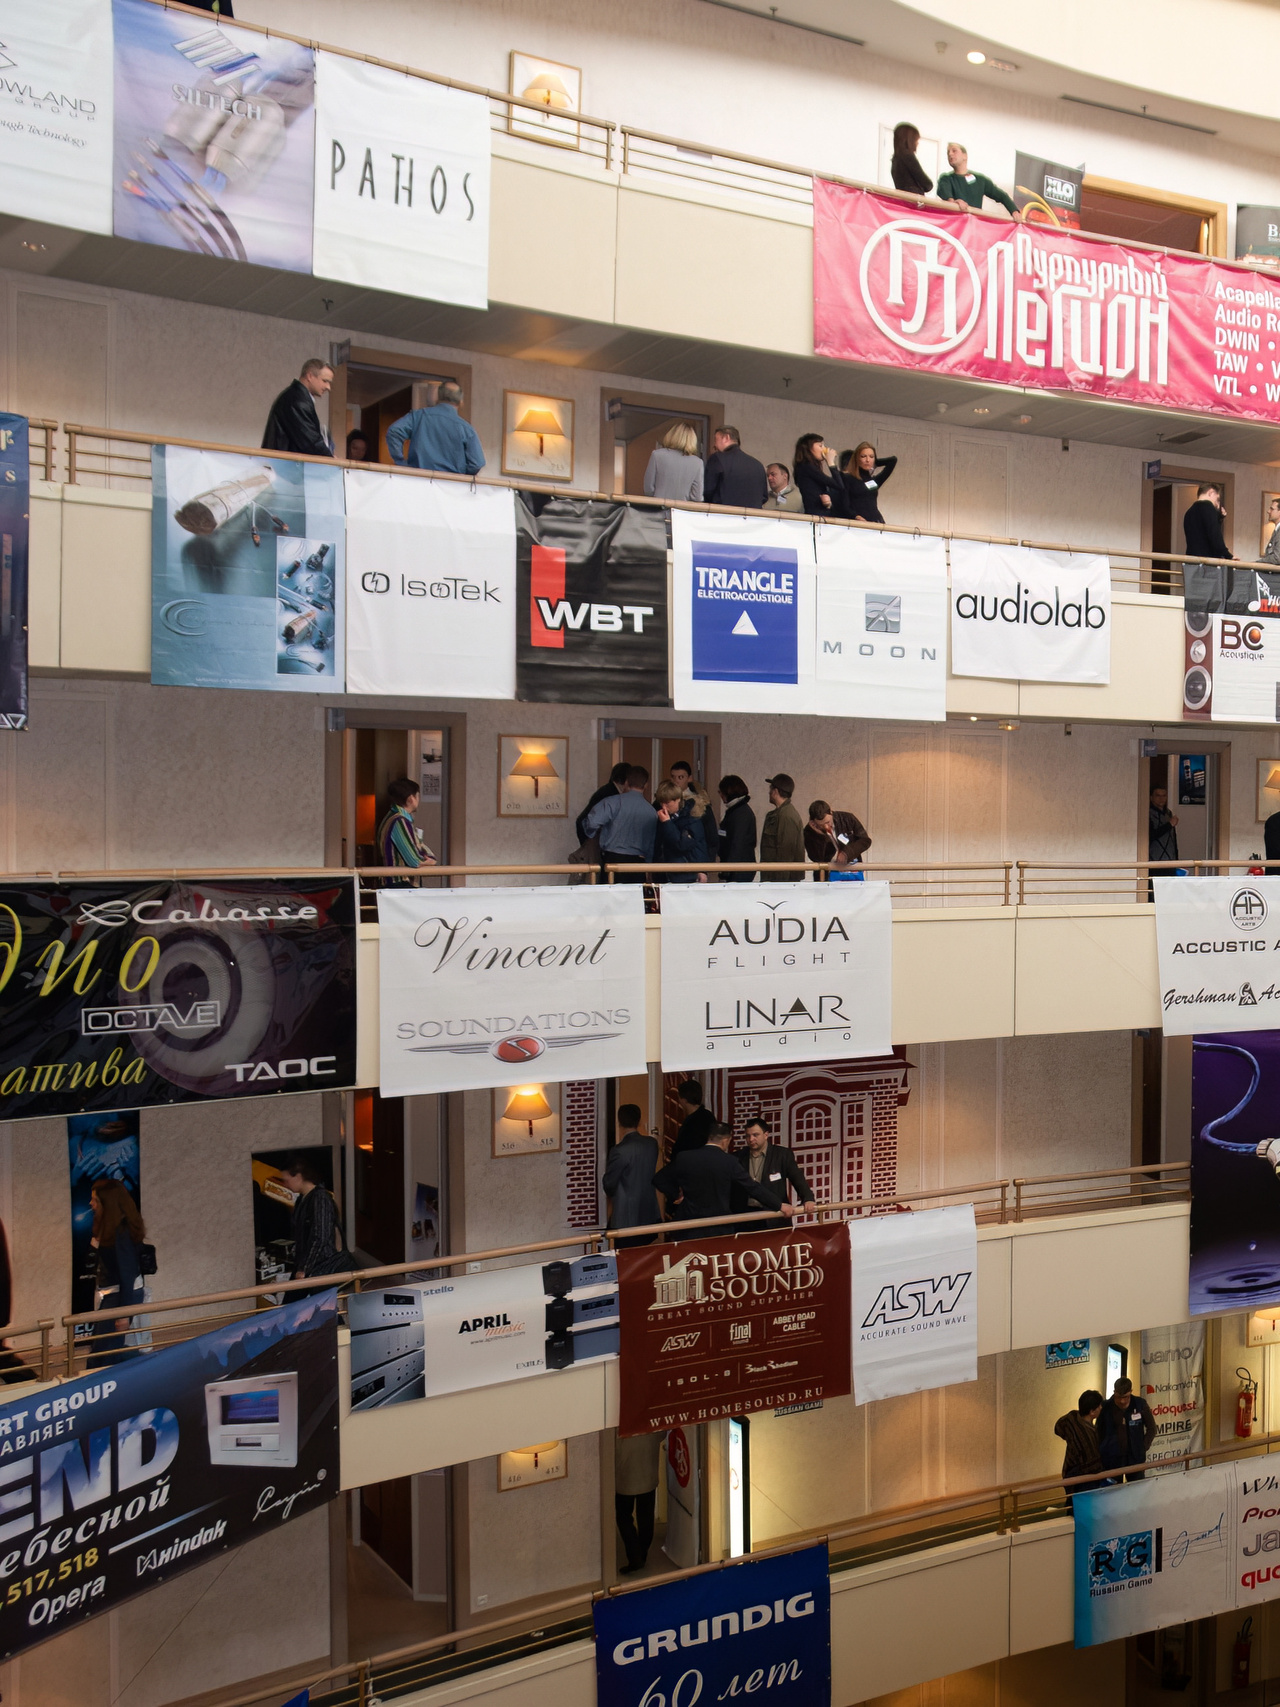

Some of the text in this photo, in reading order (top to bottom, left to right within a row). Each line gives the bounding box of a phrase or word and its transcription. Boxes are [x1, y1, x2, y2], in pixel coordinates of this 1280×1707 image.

[171, 83, 262, 121] SILTECH
[332, 139, 475, 222] PATHOS
[1016, 233, 1169, 301] Пурпурный
[1215, 304, 1261, 329] Audio
[1215, 327, 1260, 353] DWIN
[1213, 350, 1249, 374] TAW
[1213, 375, 1242, 398] VTL
[401, 573, 502, 603] IsoTek
[696, 566, 794, 595] TRIANGLE
[697, 589, 793, 605] ELECTROACOUSTIQUE
[955, 582, 1106, 630] audiolab
[538, 599, 654, 633] WBT
[823, 640, 937, 661] MOON
[1219, 650, 1265, 661] Acoustique
[132, 900, 318, 924] Cabasse
[709, 913, 850, 946] AUDIA
[413, 916, 616, 974] Vincent
[1172, 939, 1266, 955] ACCUSTIC
[707, 951, 851, 969] FLIGHT
[705, 995, 851, 1030] LINAR
[1163, 987, 1237, 1012] Gershman
[87, 1003, 217, 1030] OCTAVE
[396, 1008, 632, 1040] SOUNDATIONS
[706, 1031, 851, 1050] audio
[225, 1056, 337, 1082] TAOC
[710, 1243, 814, 1280] HOME
[709, 1266, 814, 1303] SOUND
[647, 1291, 814, 1322] GREAT SOUND SUPPLIER
[861, 1272, 972, 1328] ASW
[458, 1313, 512, 1334] APRIL
[485, 1321, 526, 1337] music
[773, 1311, 816, 1325] ABBEY ROAD
[783, 1322, 806, 1332] CABLE
[861, 1315, 967, 1342] ACCURATE SOUND WAVE
[660, 1331, 700, 1352] ASW
[35, 1380, 117, 1421] GROUP
[650, 1386, 824, 1428] WWW.HOMESOUND.RU
[28, 1575, 106, 1627] Opera
[613, 1591, 815, 1666] GRUNDIG
[638, 1658, 803, 1707] 60 лет
